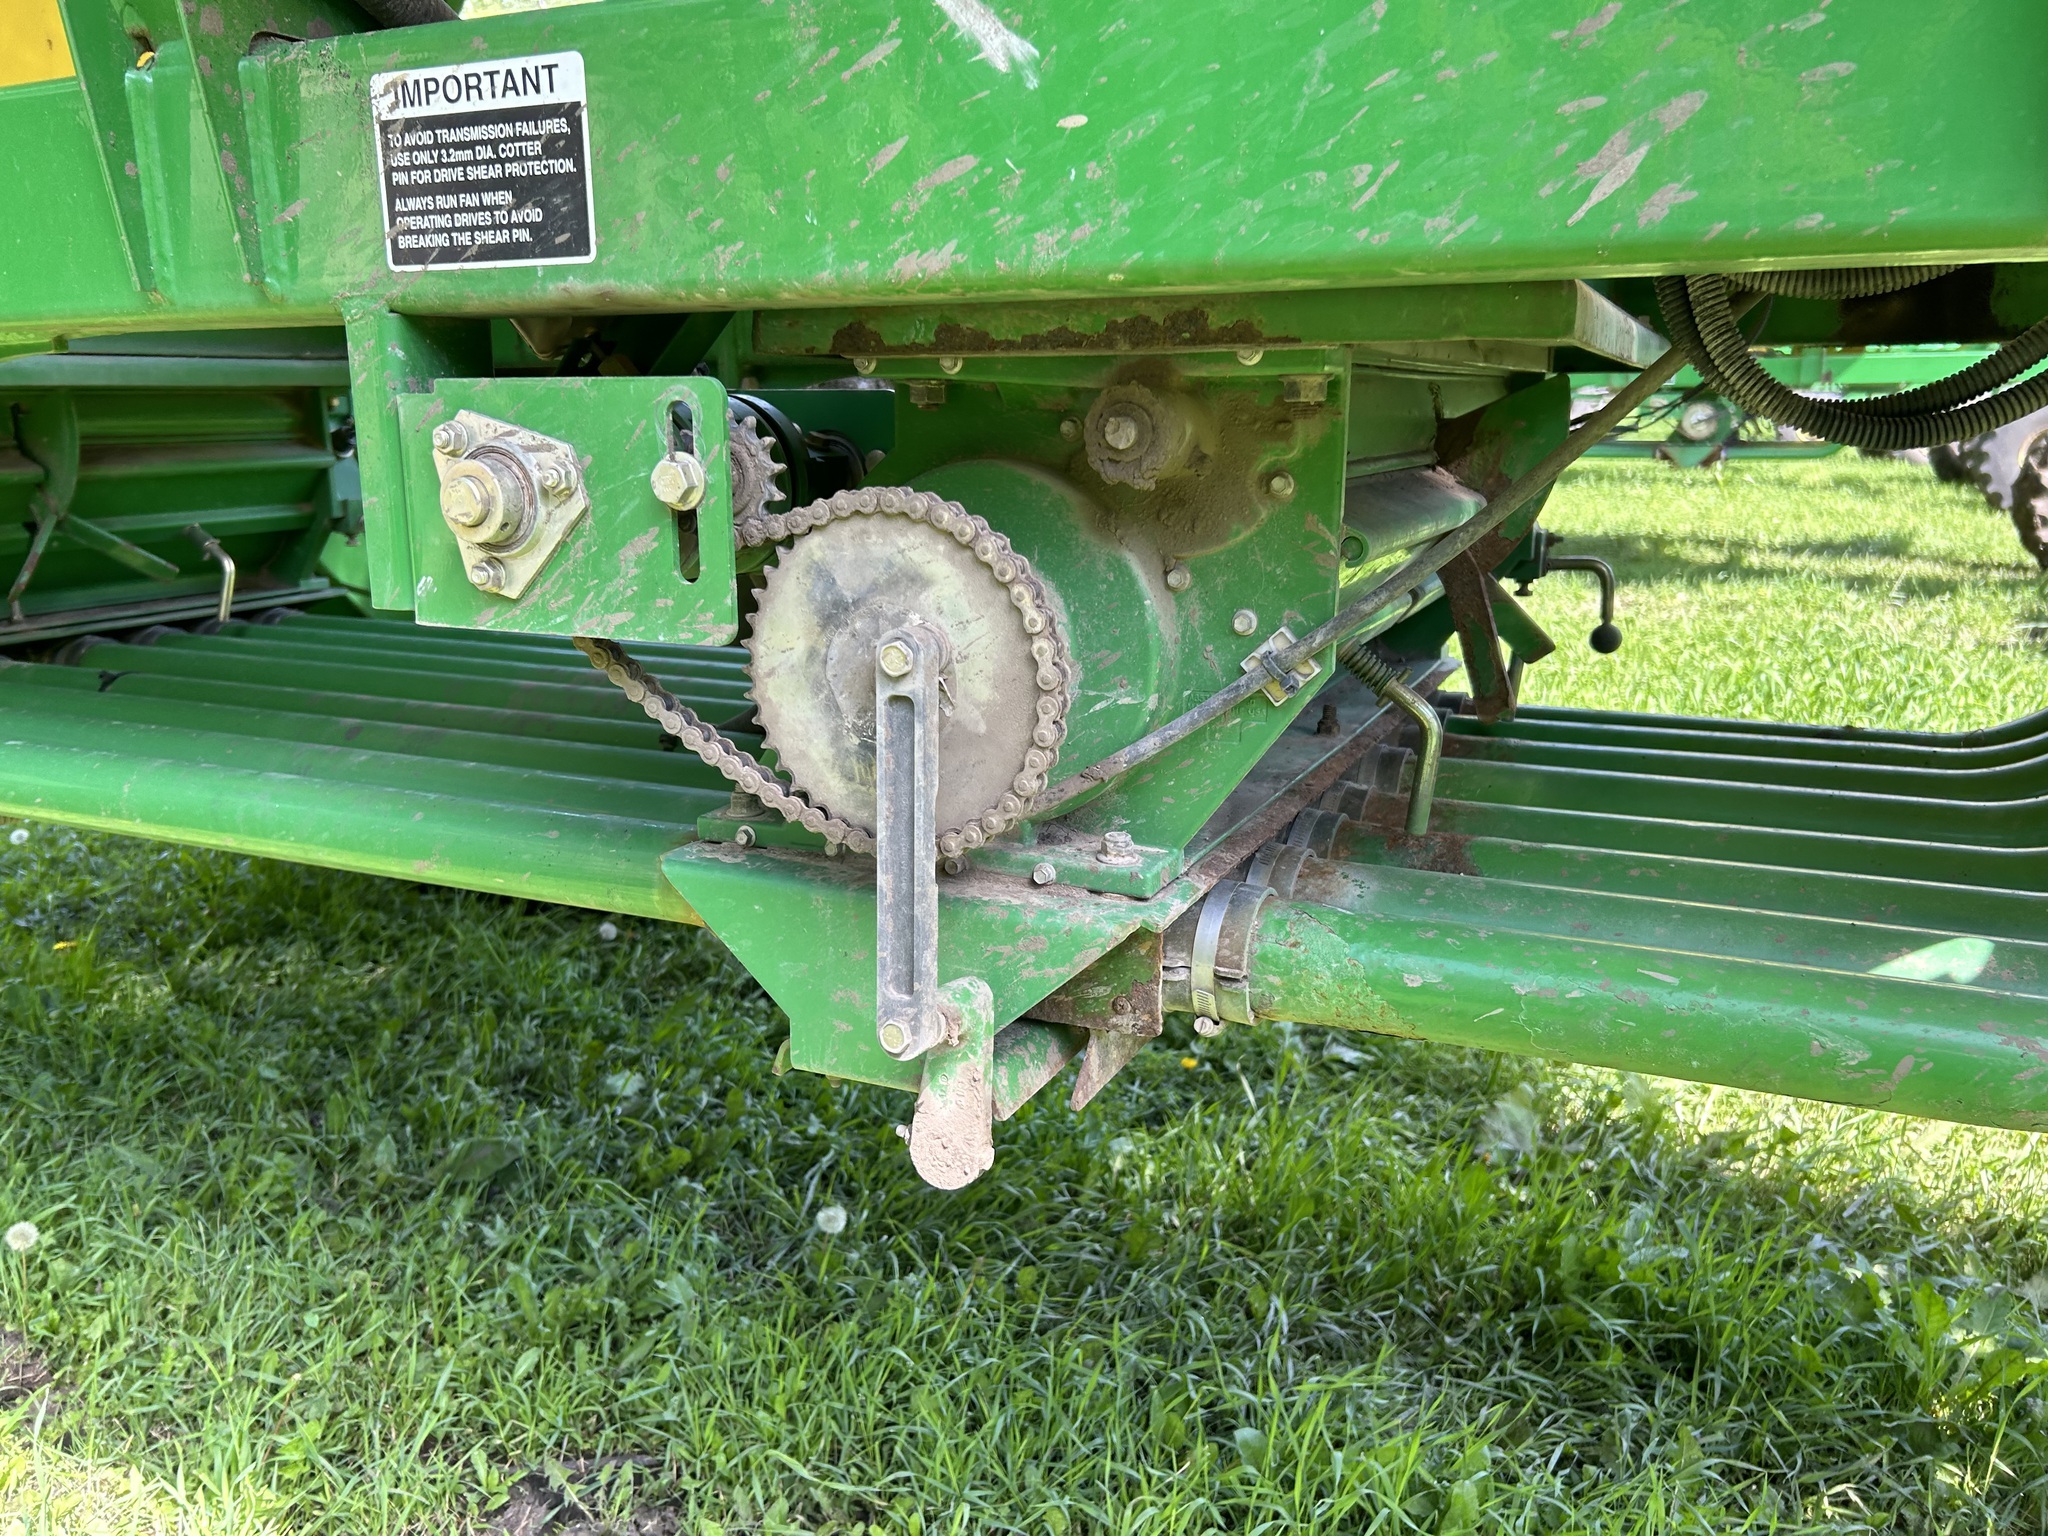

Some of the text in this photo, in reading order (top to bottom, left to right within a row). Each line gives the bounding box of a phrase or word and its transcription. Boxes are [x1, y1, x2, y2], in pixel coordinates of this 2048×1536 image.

[388, 118, 570, 147] TO AVOID TRANSMISSION FAILURES,
[413, 150, 439, 165] ONLY
[441, 148, 473, 163] 3.2mm
[476, 145, 496, 160] DIA.
[499, 141, 542, 158] COTTER
[392, 159, 576, 186] PIN FOR DRIVE SHEAR PROTECTION.
[395, 190, 512, 211] ALWAYS RUN FAN WHEN
[396, 208, 543, 230] OPERATING DRIVES TO AVOID
[398, 227, 532, 249] BREAKING THE SHEAR PIN.
